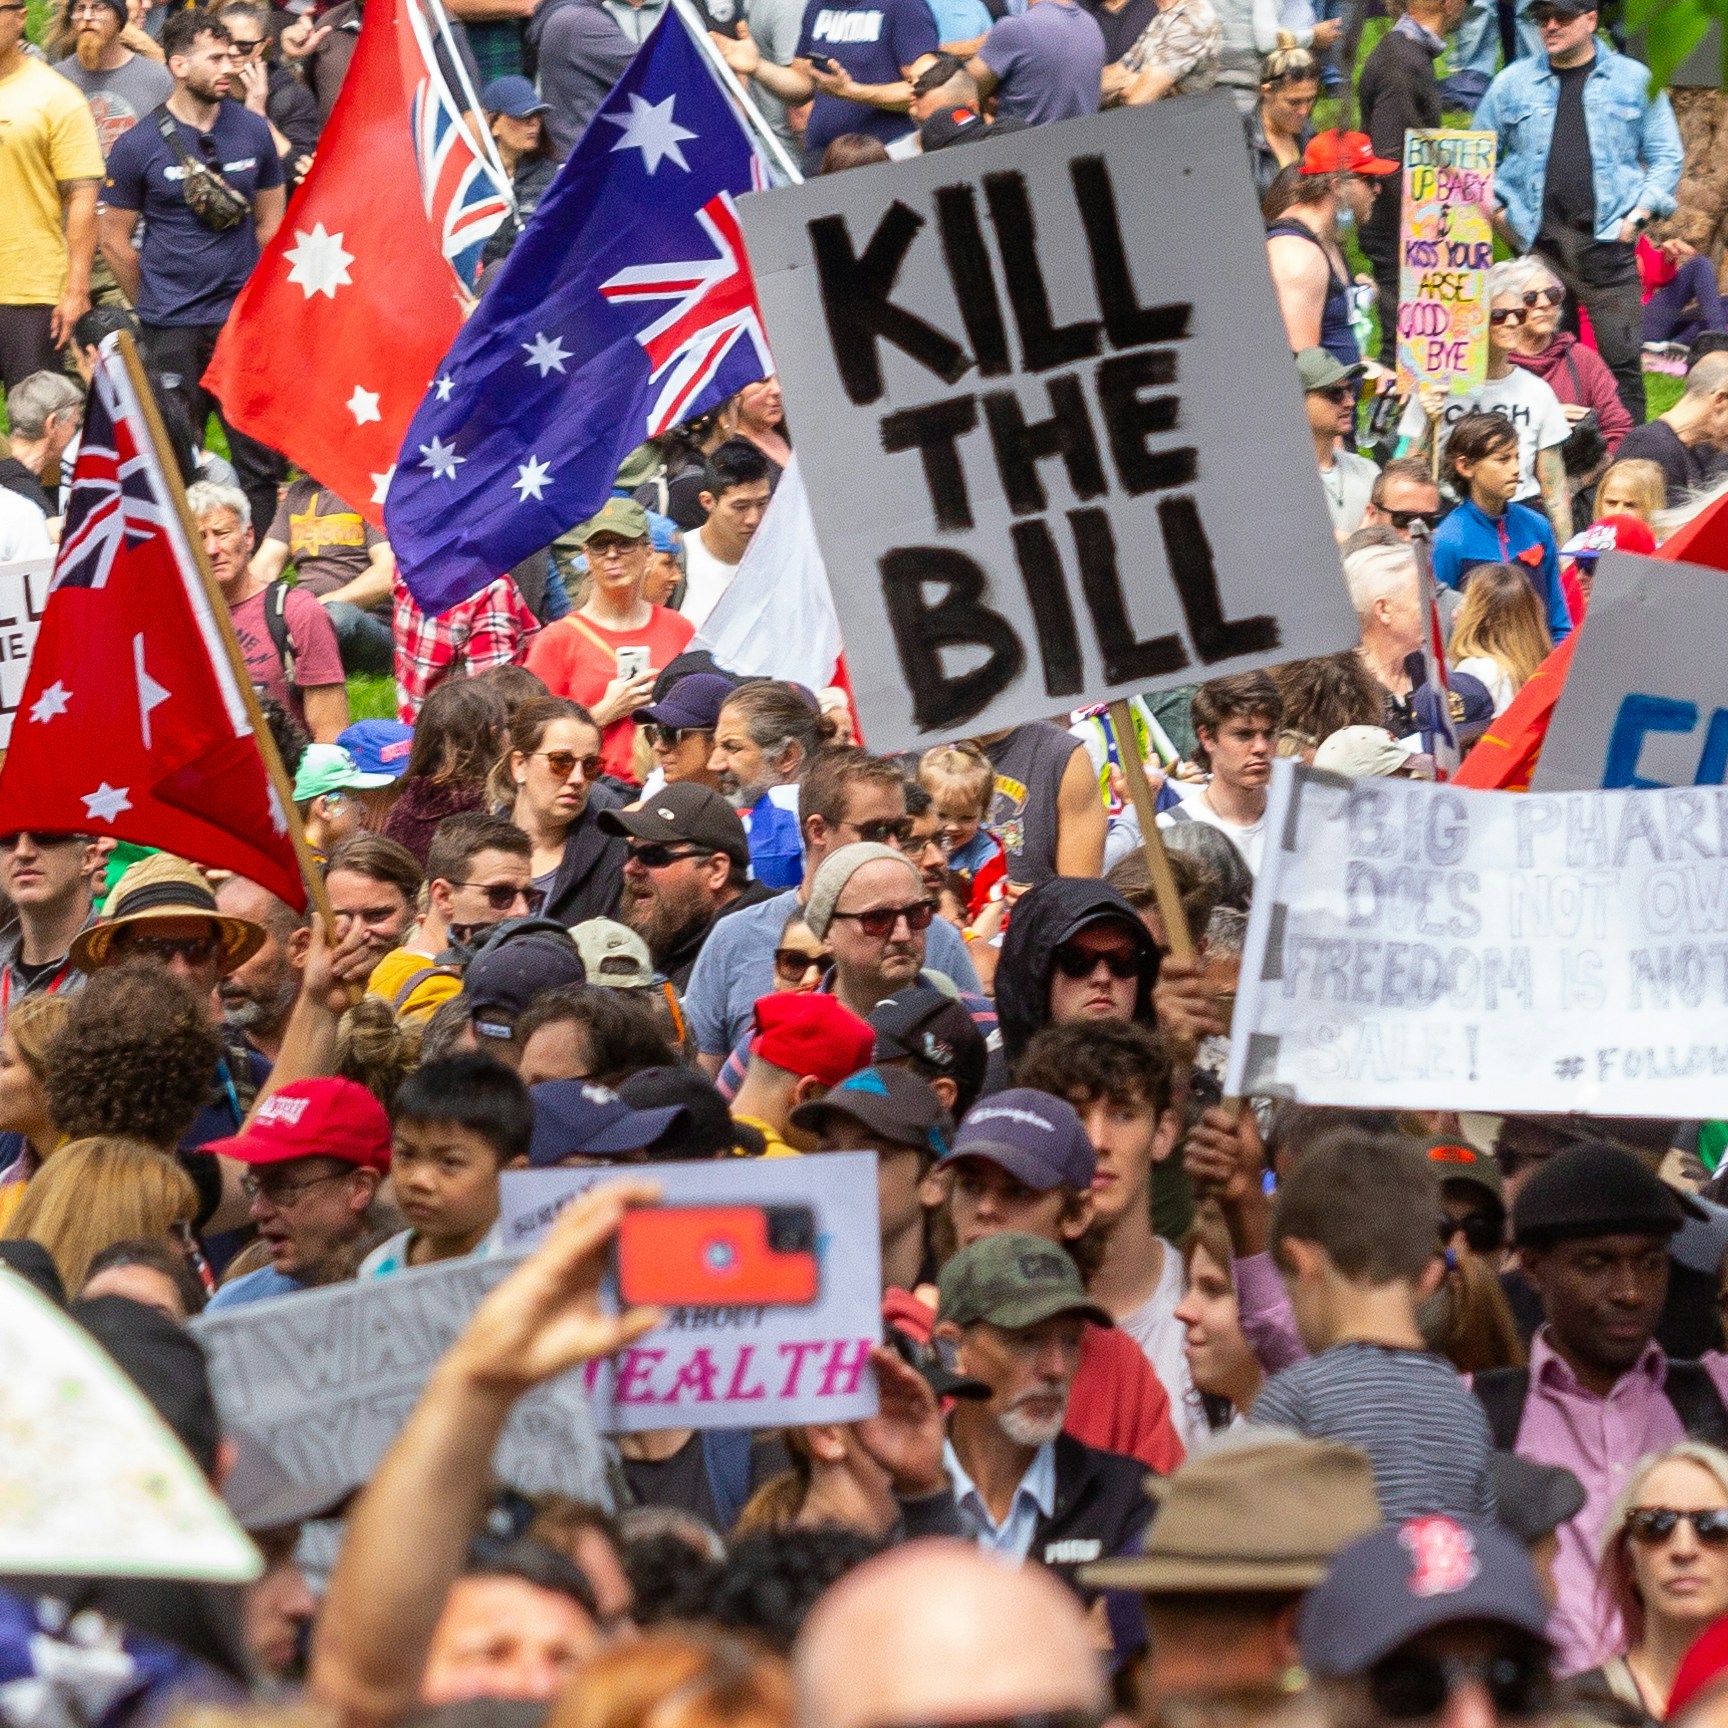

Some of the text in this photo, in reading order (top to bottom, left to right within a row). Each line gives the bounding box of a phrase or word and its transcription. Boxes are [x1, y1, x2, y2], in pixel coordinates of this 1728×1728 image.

[1411, 166, 1488, 202] UP BABY
[807, 153, 1194, 407] KILL
[1406, 241, 1492, 270] KISS YOUR
[1418, 272, 1473, 302] ARSE
[1428, 340, 1470, 371] BYE
[879, 349, 1200, 534] THE
[877, 495, 1282, 735] BILL
[1345, 787, 1471, 867] BIG
[1345, 862, 1481, 939] DOES
[1509, 872, 1620, 940] NOT
[1282, 934, 1534, 1010] FREEDOM
[1560, 947, 1606, 1010] IS
[1308, 1020, 1480, 1084] SALE!
